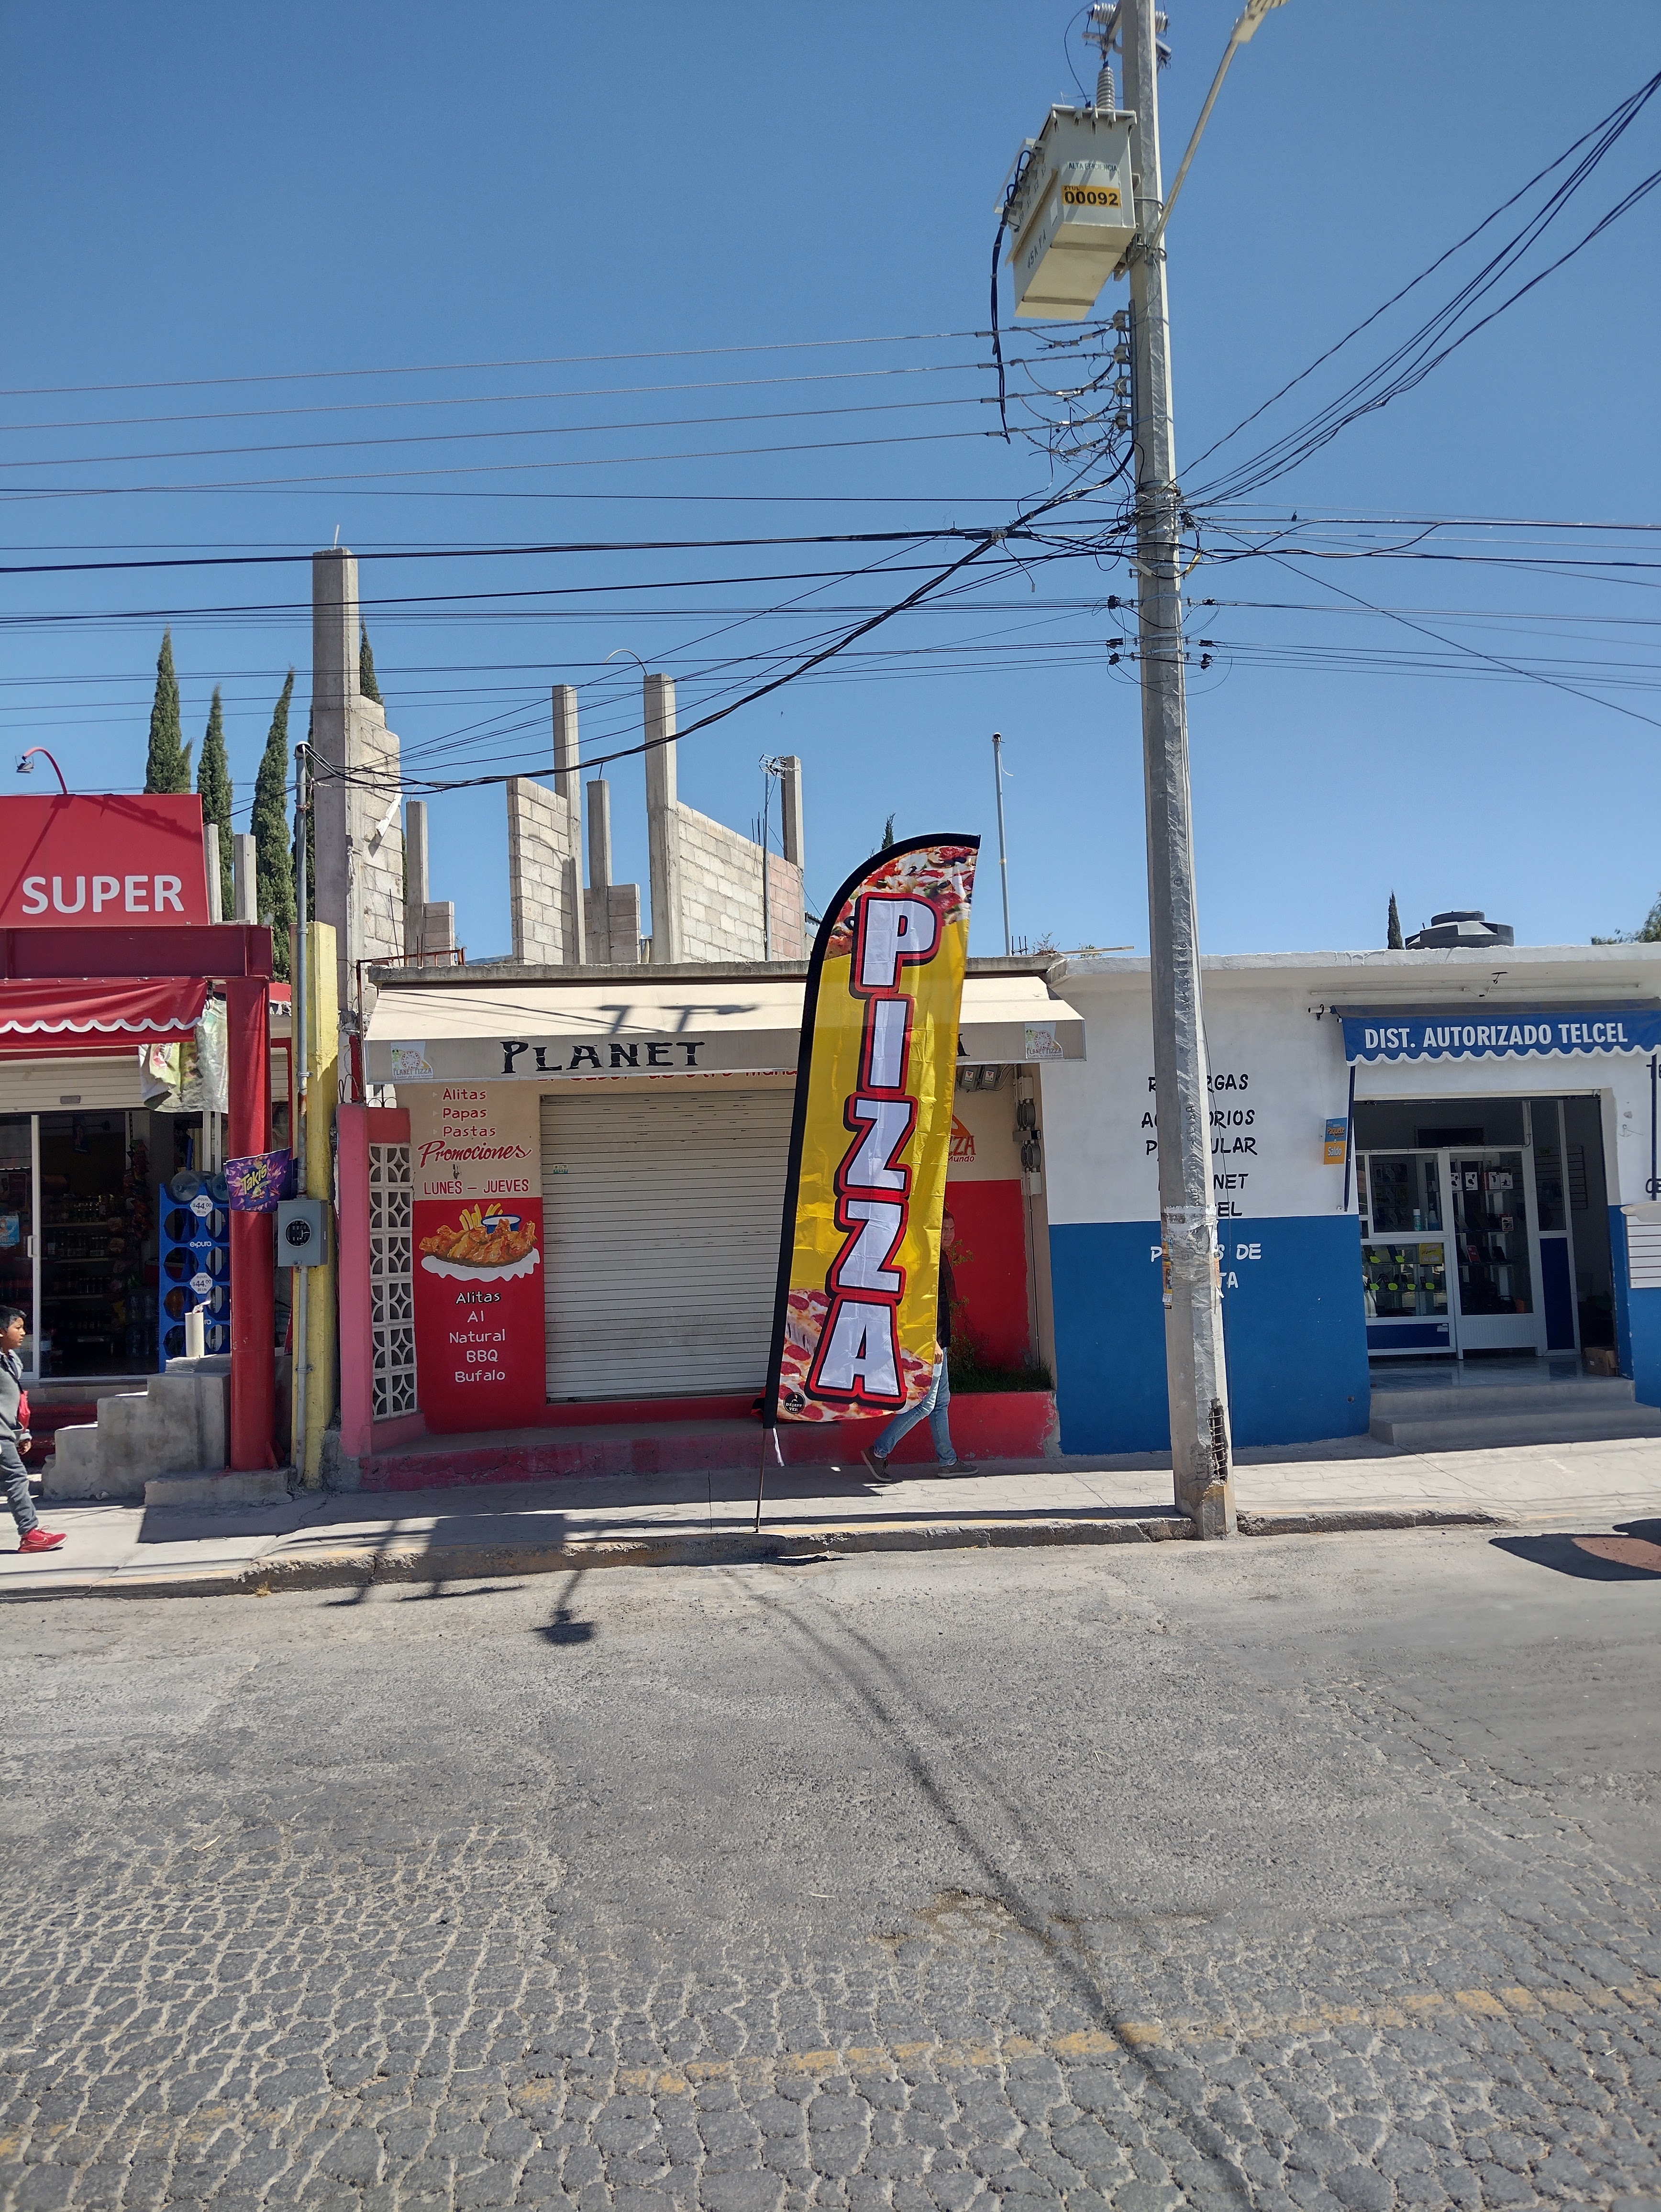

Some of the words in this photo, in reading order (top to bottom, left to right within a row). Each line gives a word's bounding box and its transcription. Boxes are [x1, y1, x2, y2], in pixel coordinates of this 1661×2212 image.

[1064, 191, 1118, 206] 00092
[22, 875, 184, 914] SUPER
[1364, 1028, 1416, 1049] DIST.
[1423, 1024, 1552, 1048] AUTORIZADO
[1558, 1023, 1628, 1044] TELCEL
[499, 1041, 705, 1074] PLANET
[1148, 1074, 1248, 1092] RRGAS
[443, 1088, 486, 1100] Alitas
[443, 1108, 487, 1121] Papas
[443, 1126, 496, 1137] Pastas
[418, 1140, 532, 1168] Promociones
[808, 893, 942, 1406] PIZZA
[1328, 1146, 1342, 1156] Saldo
[424, 1181, 462, 1195] LUNES
[483, 1179, 529, 1193] JUEVES
[1236, 1243, 1262, 1260] DE
[455, 1291, 501, 1305] Alitas
[467, 1310, 484, 1323] Al
[449, 1328, 506, 1344] Natural
[466, 1349, 498, 1363] BBQ
[454, 1369, 506, 1382] Bufalo
